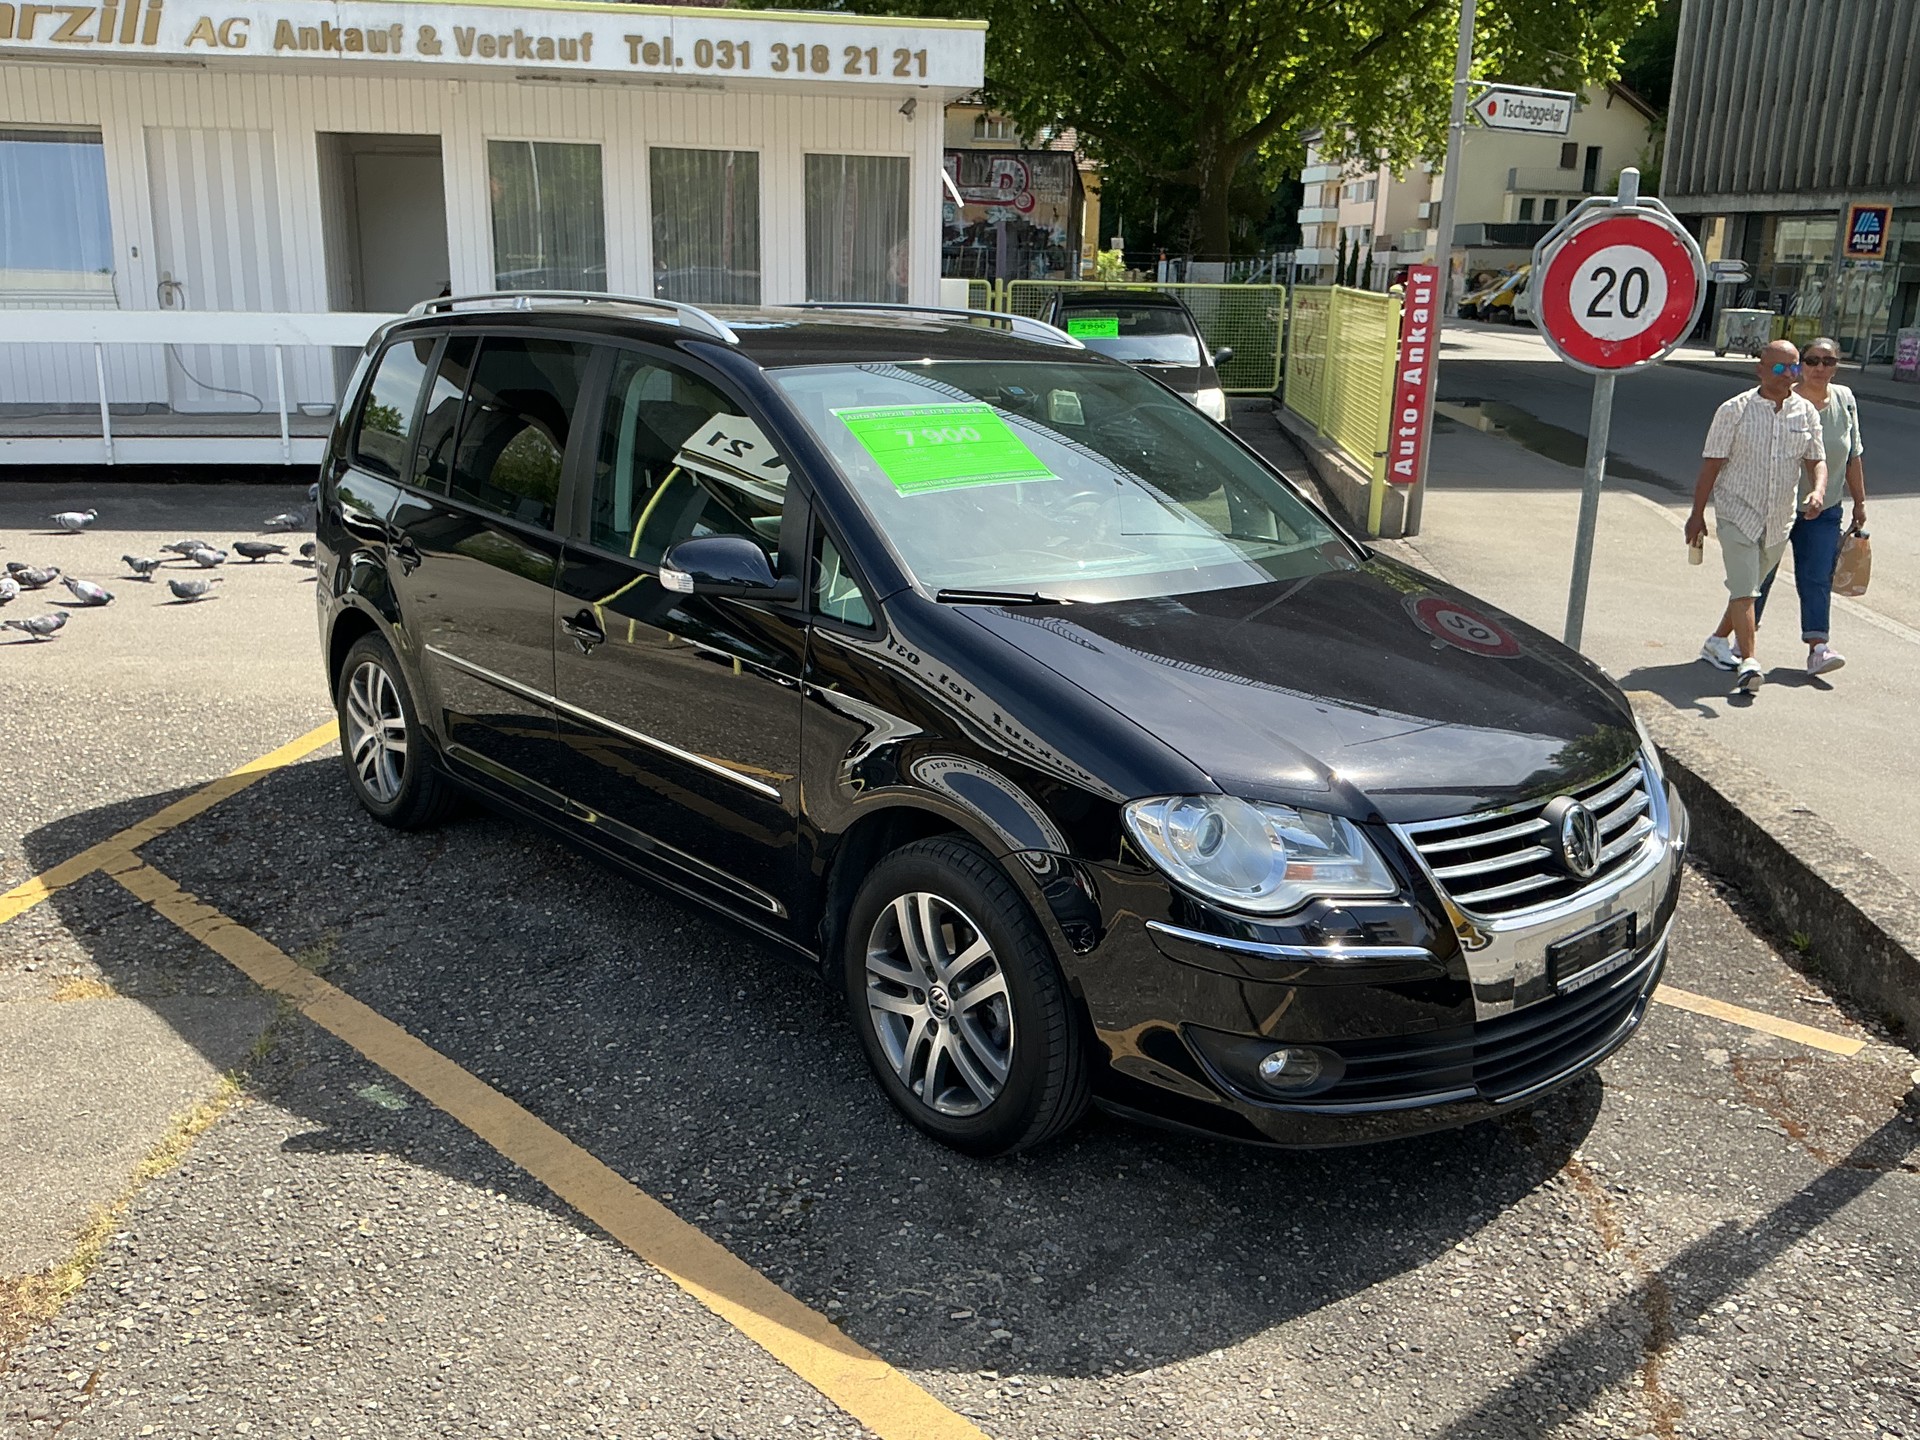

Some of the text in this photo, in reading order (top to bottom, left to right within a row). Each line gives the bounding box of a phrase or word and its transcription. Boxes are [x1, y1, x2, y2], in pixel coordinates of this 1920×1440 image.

[184, 16, 250, 49] AG
[273, 19, 927, 77] Ankauf & Verkauf Tel. 031 318 21 21
[1852, 233, 1880, 244] ALDI
[1586, 266, 1650, 319] 20
[1394, 272, 1433, 476] Auto Ankauf
